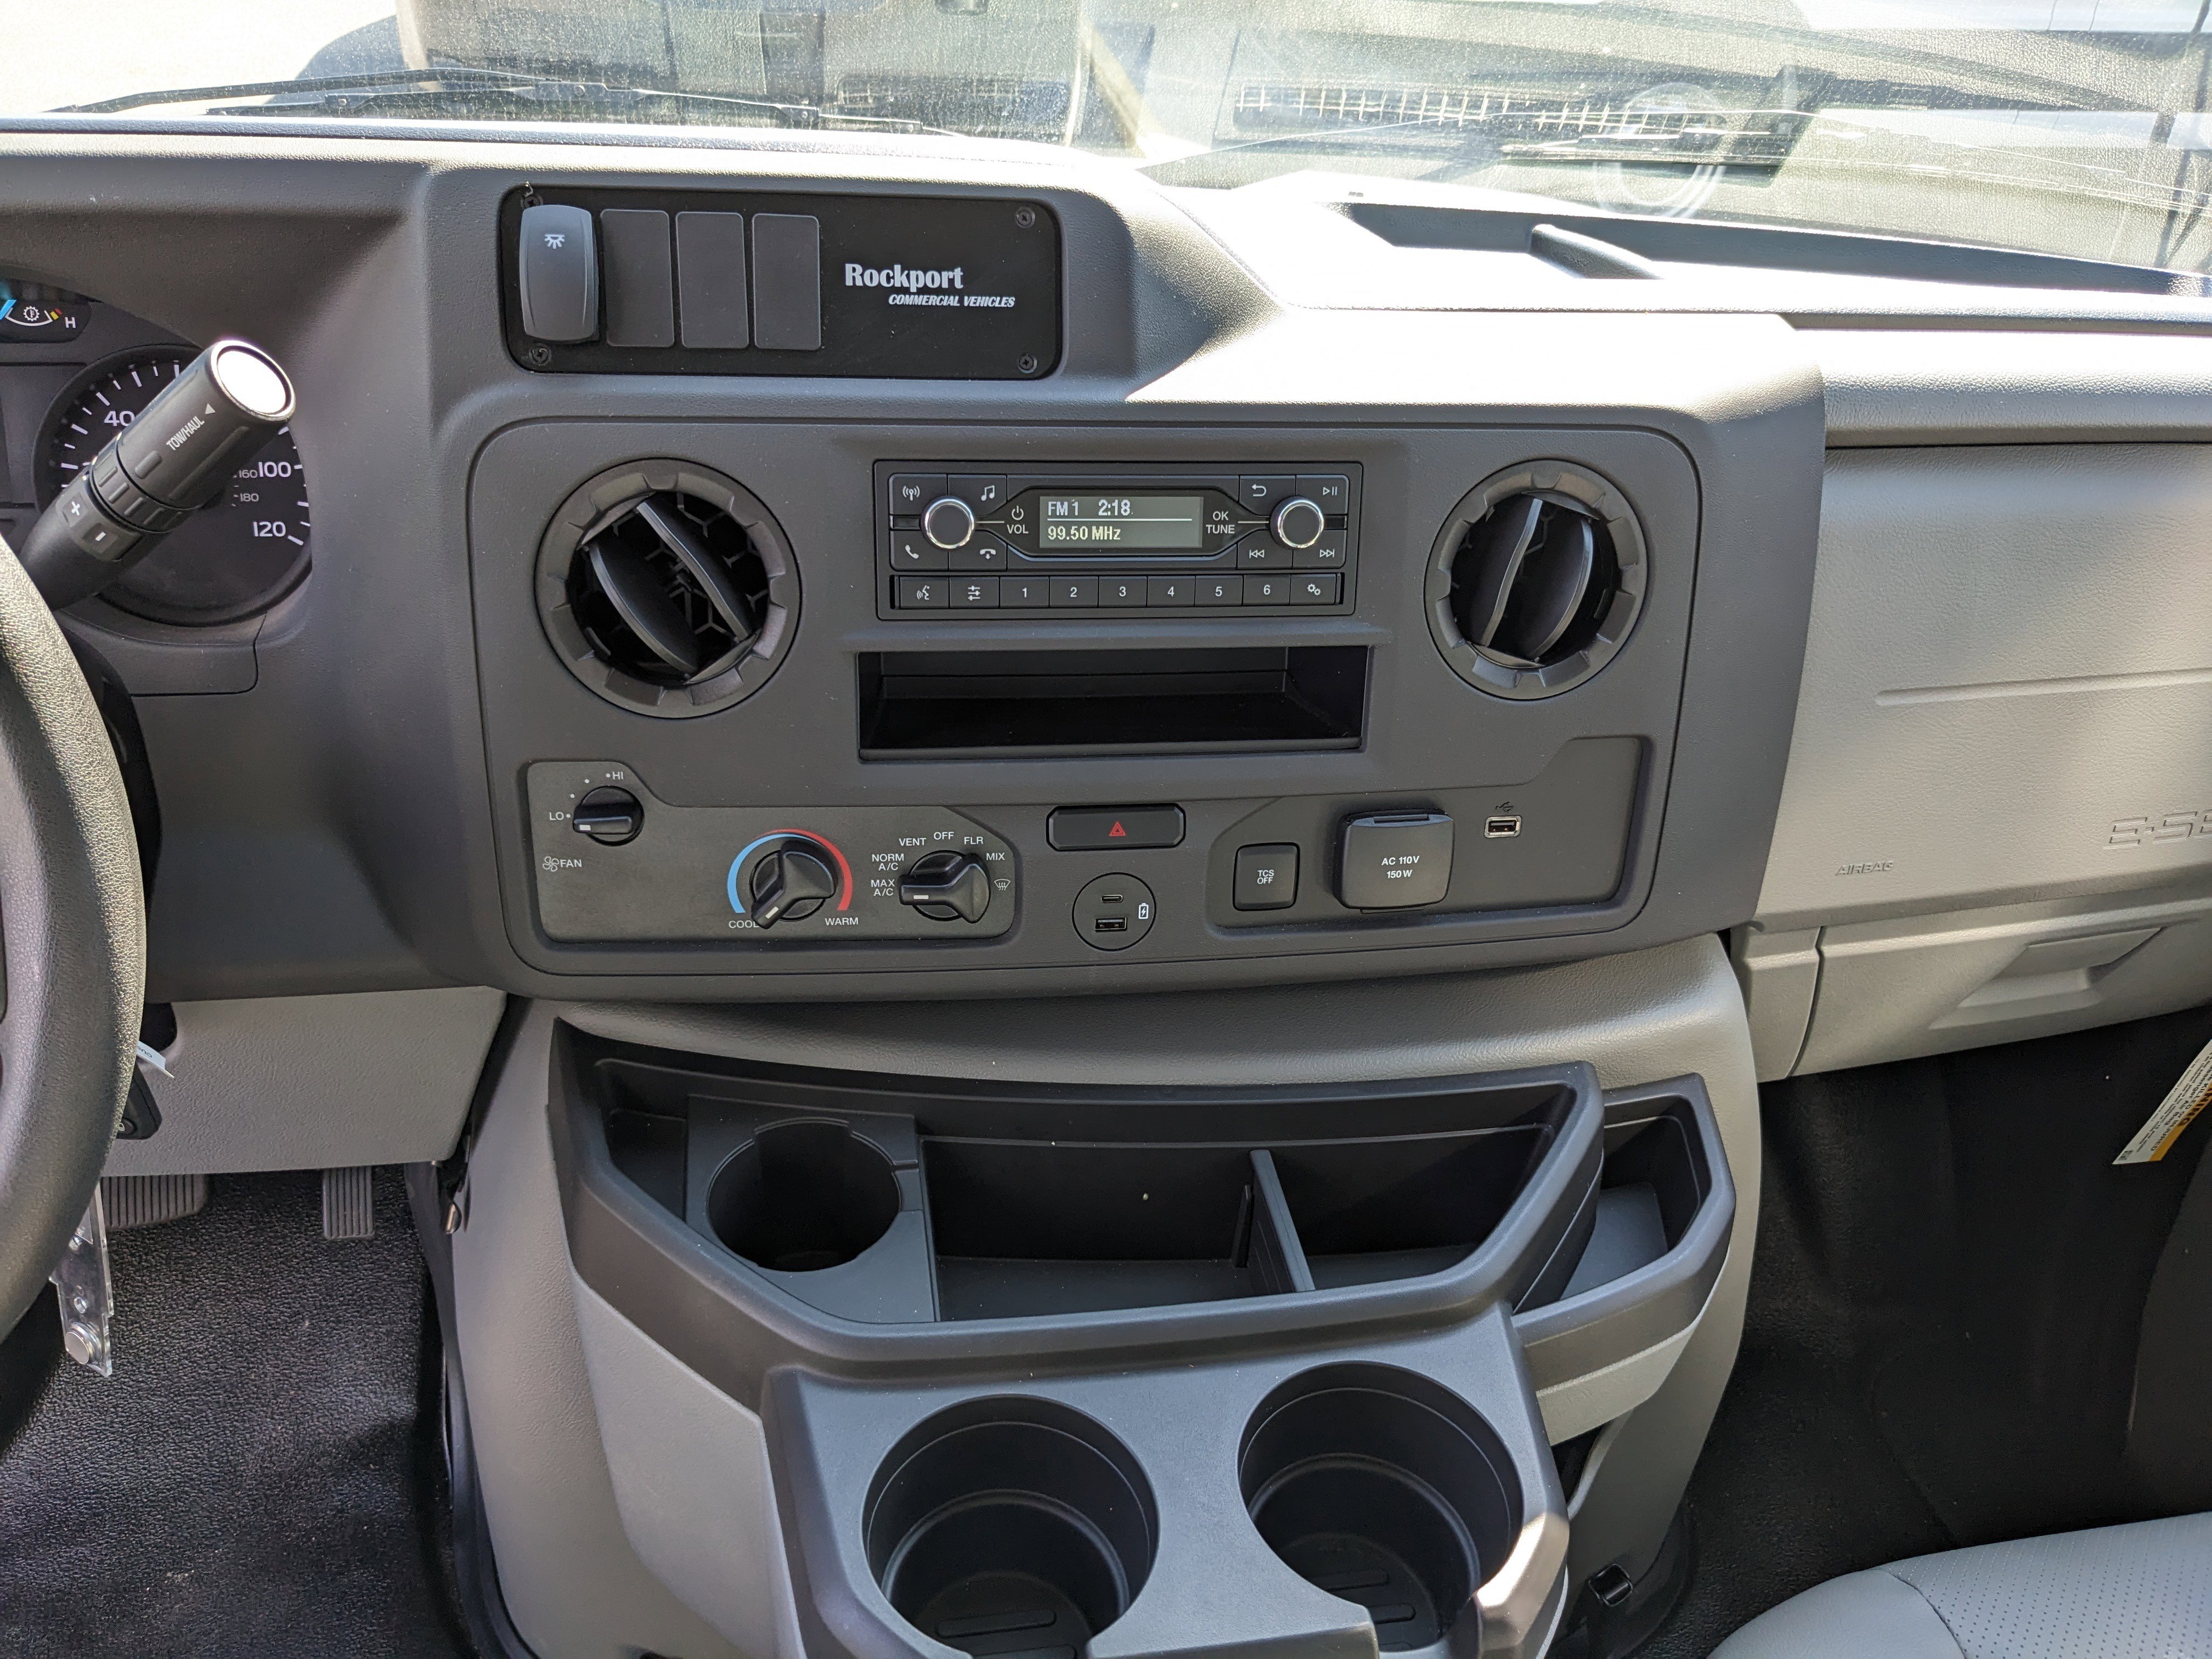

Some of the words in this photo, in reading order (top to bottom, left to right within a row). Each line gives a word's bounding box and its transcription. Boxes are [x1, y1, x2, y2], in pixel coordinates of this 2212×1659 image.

[845, 263, 963, 292] Rockport
[888, 294, 960, 306] COMMERCIAL
[963, 296, 1015, 308] VEHICLES
[65, 317, 76, 329] H
[103, 410, 135, 427] 40
[166, 416, 205, 451] TOW/HAUL
[239, 470, 258, 478] 160
[258, 461, 292, 478] 100
[240, 493, 259, 502] 180
[1048, 501, 1068, 516] FM
[1098, 499, 1131, 516] 2:18
[1212, 511, 1229, 521] OK
[253, 521, 286, 537] 120
[1007, 524, 1029, 534] VOL
[1048, 526, 1088, 540] 99.50
[1091, 526, 1121, 540] MHz
[1206, 524, 1235, 534] TUNE
[1022, 588, 1027, 598] 1
[1070, 587, 1077, 597] 2
[1119, 586, 1126, 597] 3
[1167, 586, 1175, 597] 4
[1215, 586, 1222, 596] 5
[1263, 585, 1271, 595] 6
[613, 771, 624, 780] HI
[549, 811, 564, 821] LO
[934, 832, 955, 840] OFF
[964, 837, 984, 845] FLR
[899, 837, 927, 846] VENT
[872, 853, 904, 862] NORM
[986, 853, 1005, 861] MIX
[1381, 857, 1396, 866] AC
[560, 859, 582, 868] FAN
[879, 862, 899, 871] A/C
[1835, 860, 1894, 876] AIRBAG
[871, 879, 895, 888] MAX
[874, 888, 894, 896] A/C
[729, 920, 759, 928] COOL
[825, 917, 859, 926] WARM
